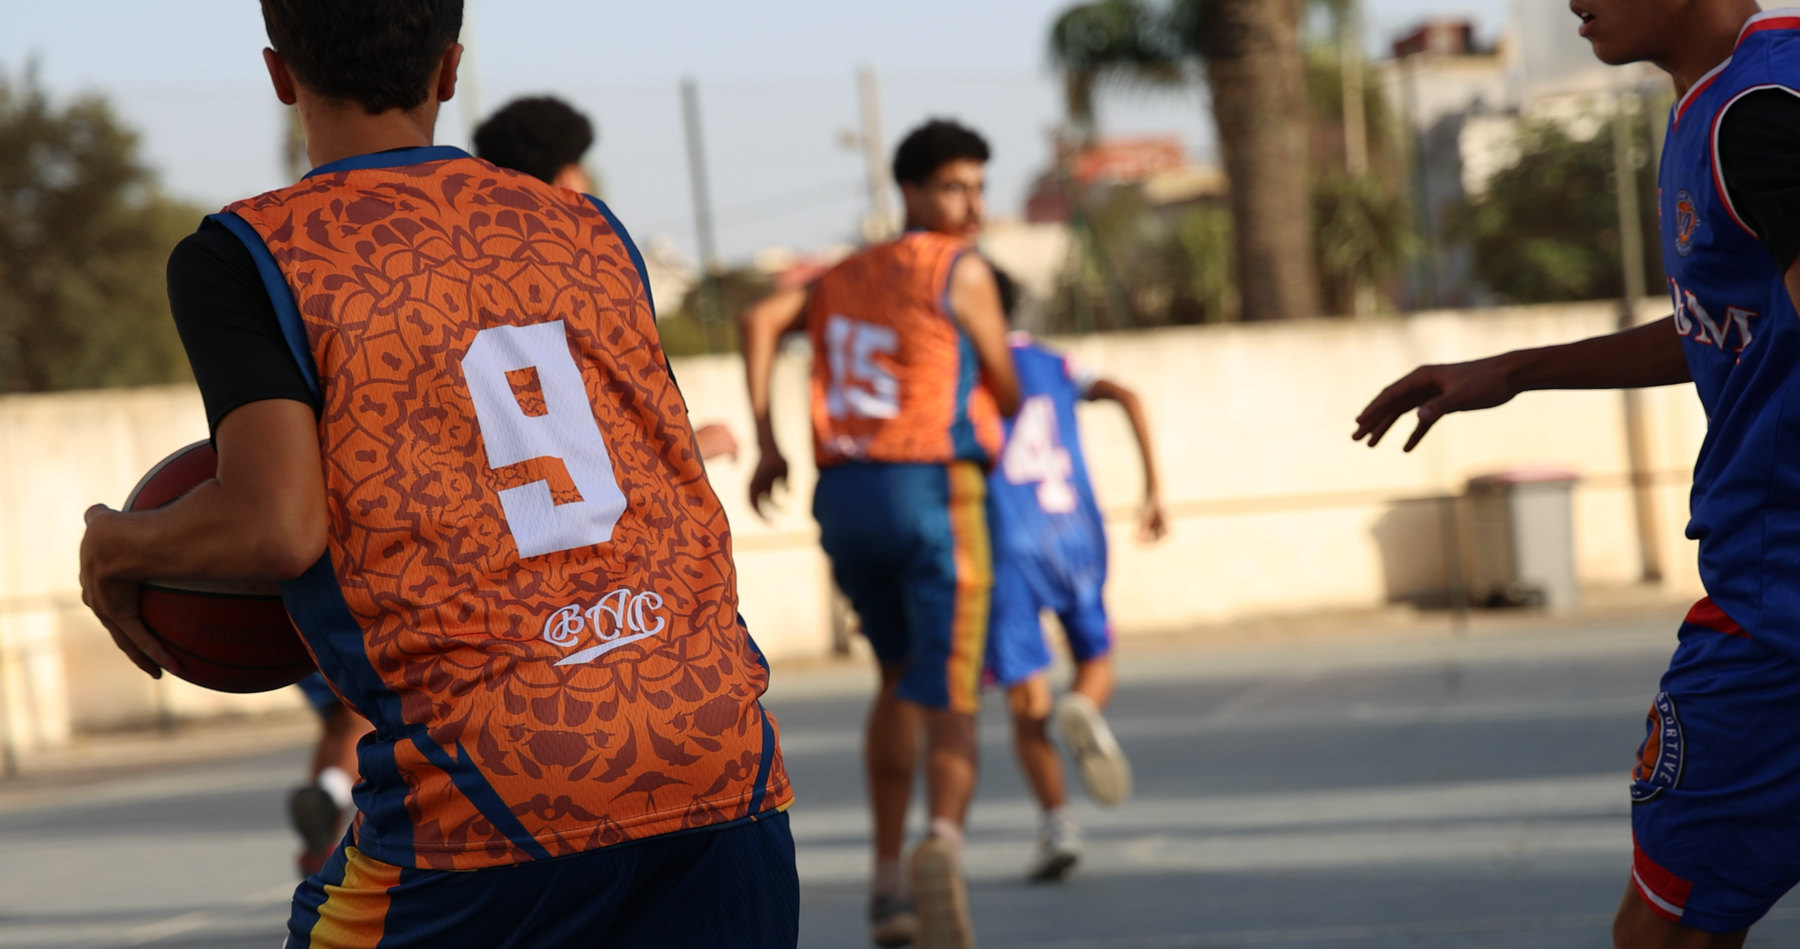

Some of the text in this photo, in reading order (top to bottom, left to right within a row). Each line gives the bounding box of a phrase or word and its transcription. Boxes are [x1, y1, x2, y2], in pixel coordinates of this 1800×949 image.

[826, 313, 898, 419] 15
[461, 319, 627, 559] 9
[1002, 394, 1075, 513] 4
[543, 588, 666, 666] BAC
